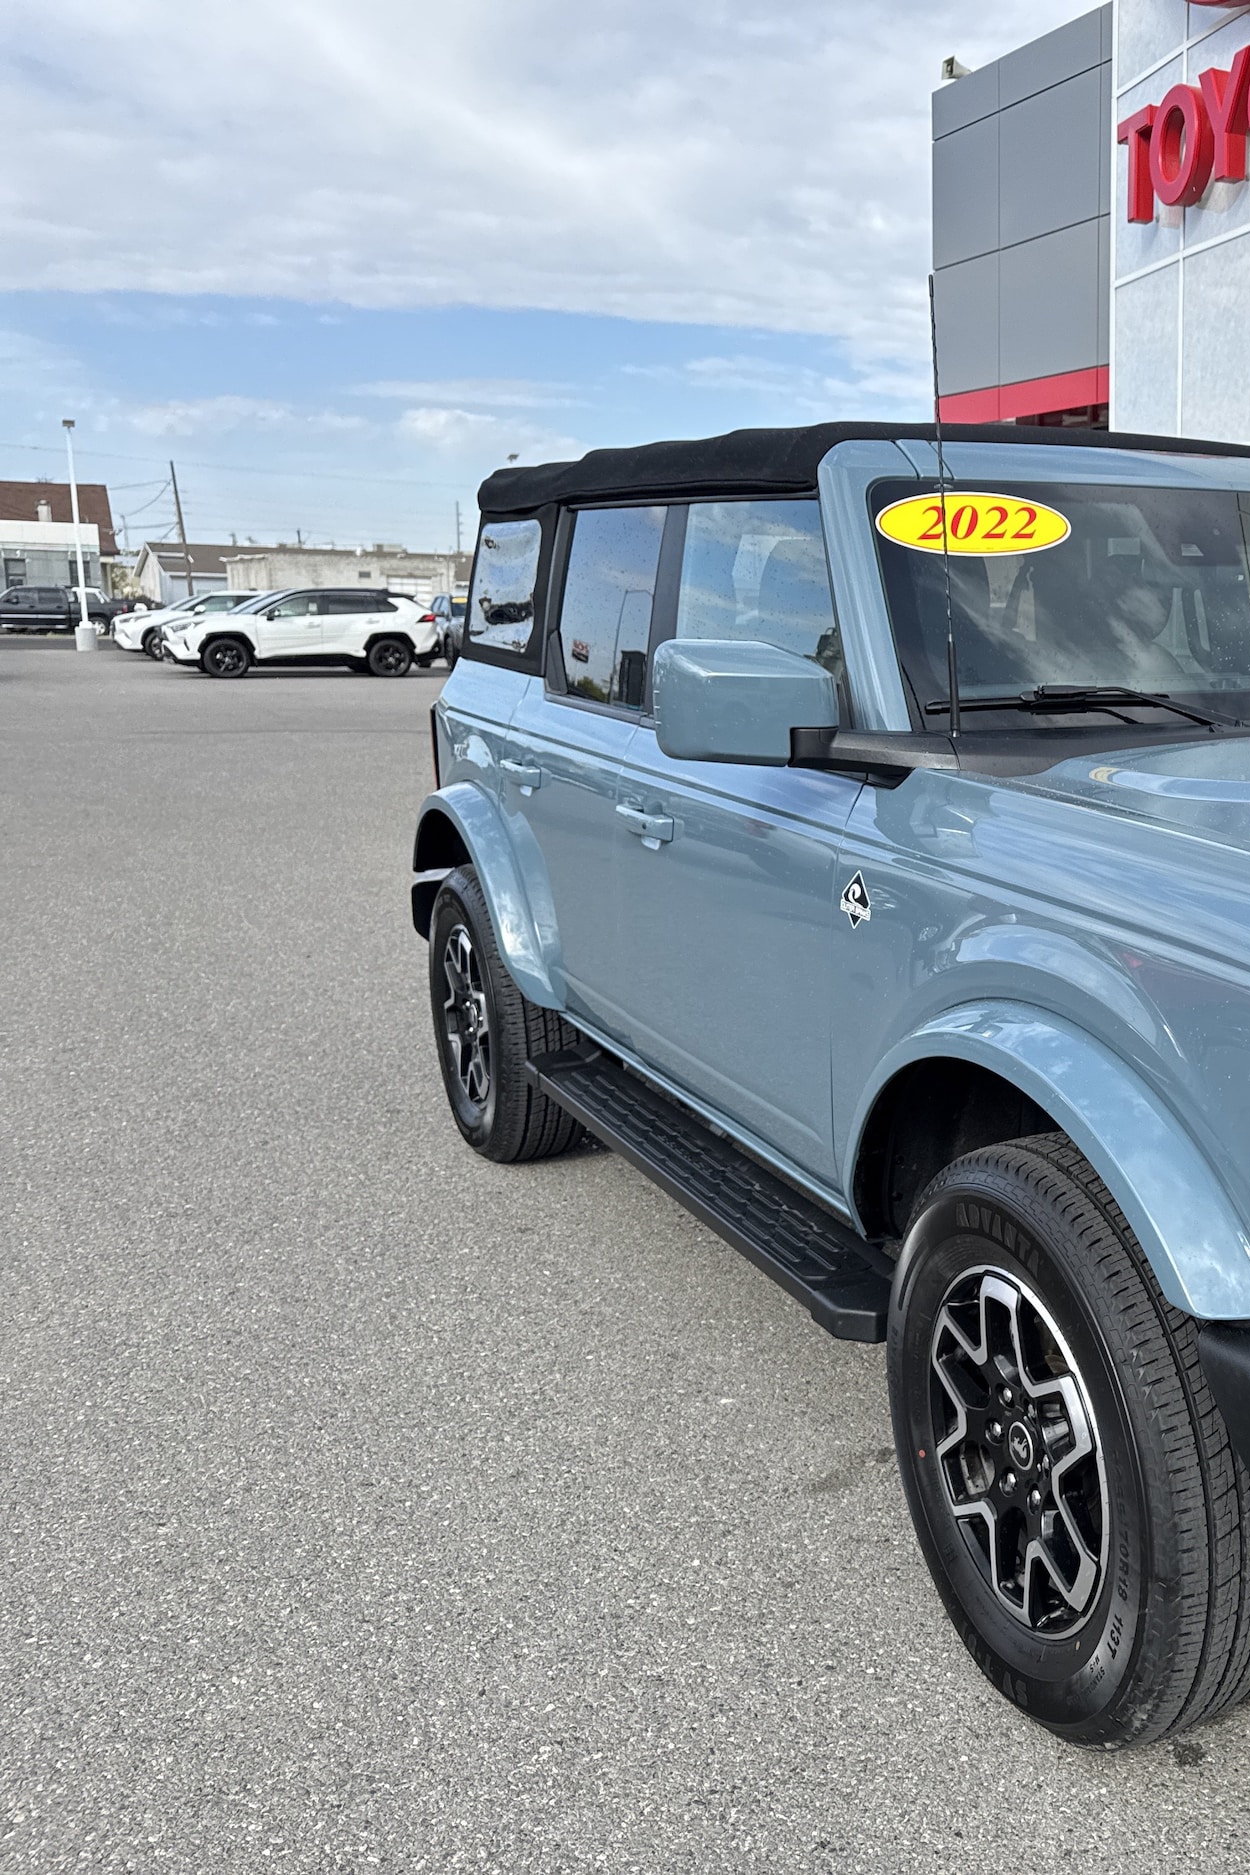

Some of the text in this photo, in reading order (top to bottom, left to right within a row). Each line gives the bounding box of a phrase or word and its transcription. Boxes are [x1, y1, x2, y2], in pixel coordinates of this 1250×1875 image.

[917, 504, 1038, 540] 2022
[956, 1203, 1039, 1278] ADVANTA
[1106, 1613, 1124, 1661] 113T
